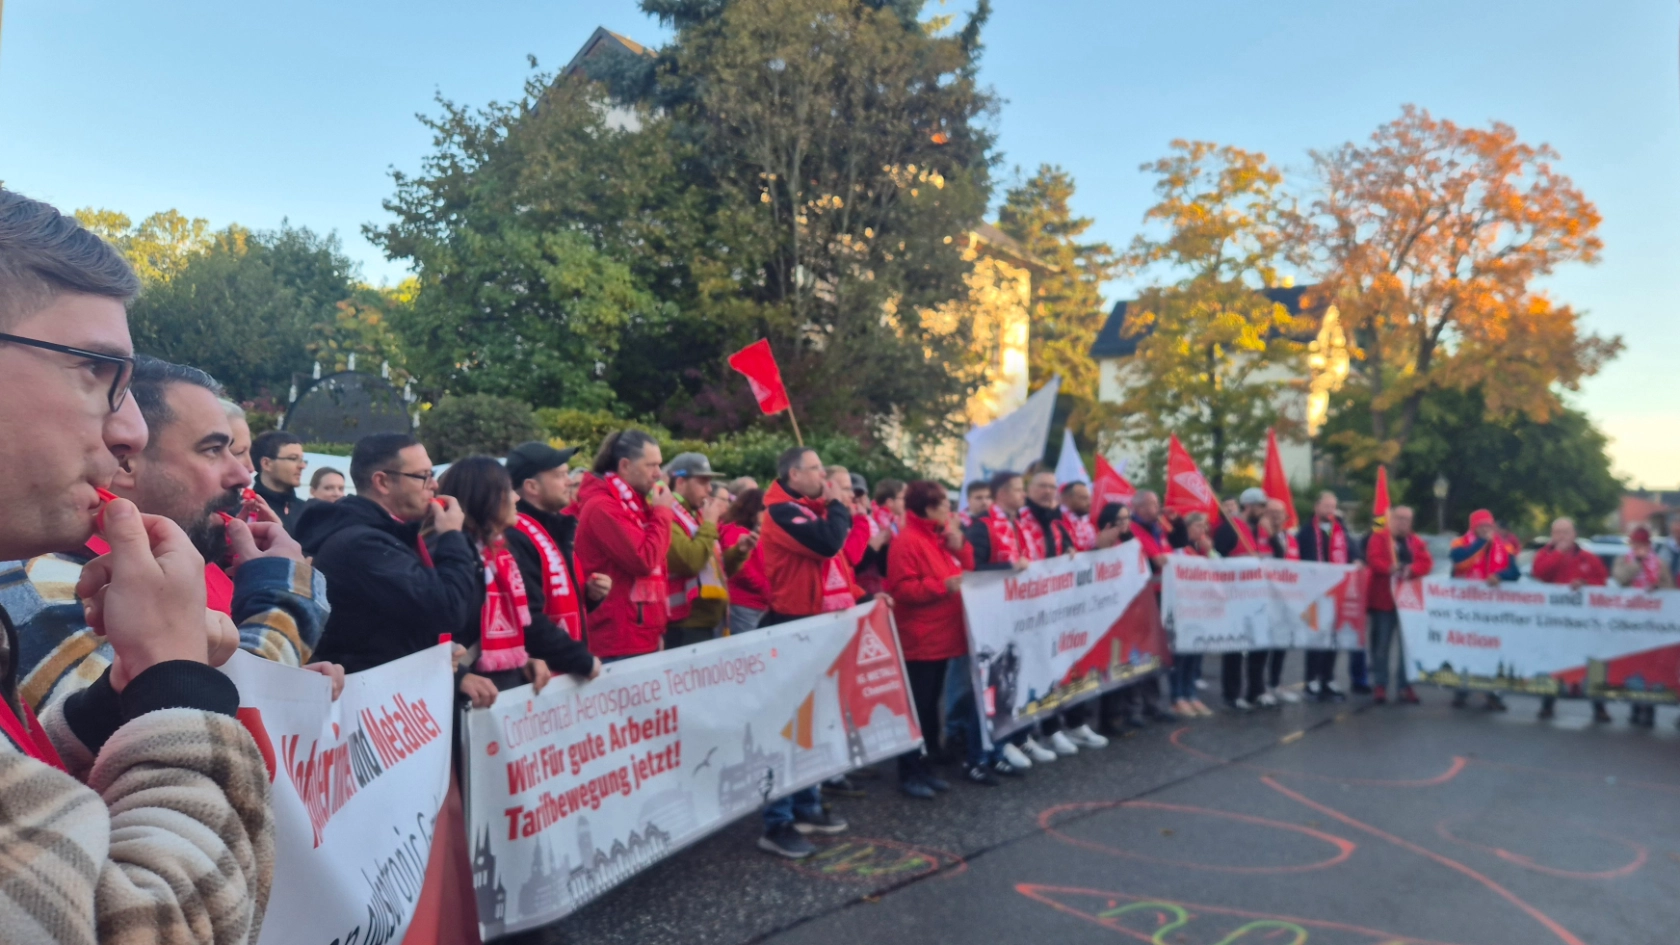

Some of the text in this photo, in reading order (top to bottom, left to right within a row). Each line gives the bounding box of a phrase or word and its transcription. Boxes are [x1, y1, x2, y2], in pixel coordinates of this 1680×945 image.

[1428, 584, 1545, 605] Metallerinnen
[1549, 591, 1583, 606] und
[1588, 593, 1662, 611] Metaller
[1428, 627, 1501, 649] in Aktion
[360, 692, 442, 769] Metaller
[504, 653, 766, 749] Continental Aerospace Technologies
[505, 766, 632, 841] Tarifbewegung
[631, 740, 681, 789] jetzt!
[506, 705, 679, 796] Wir! Für gute Arbeit!
